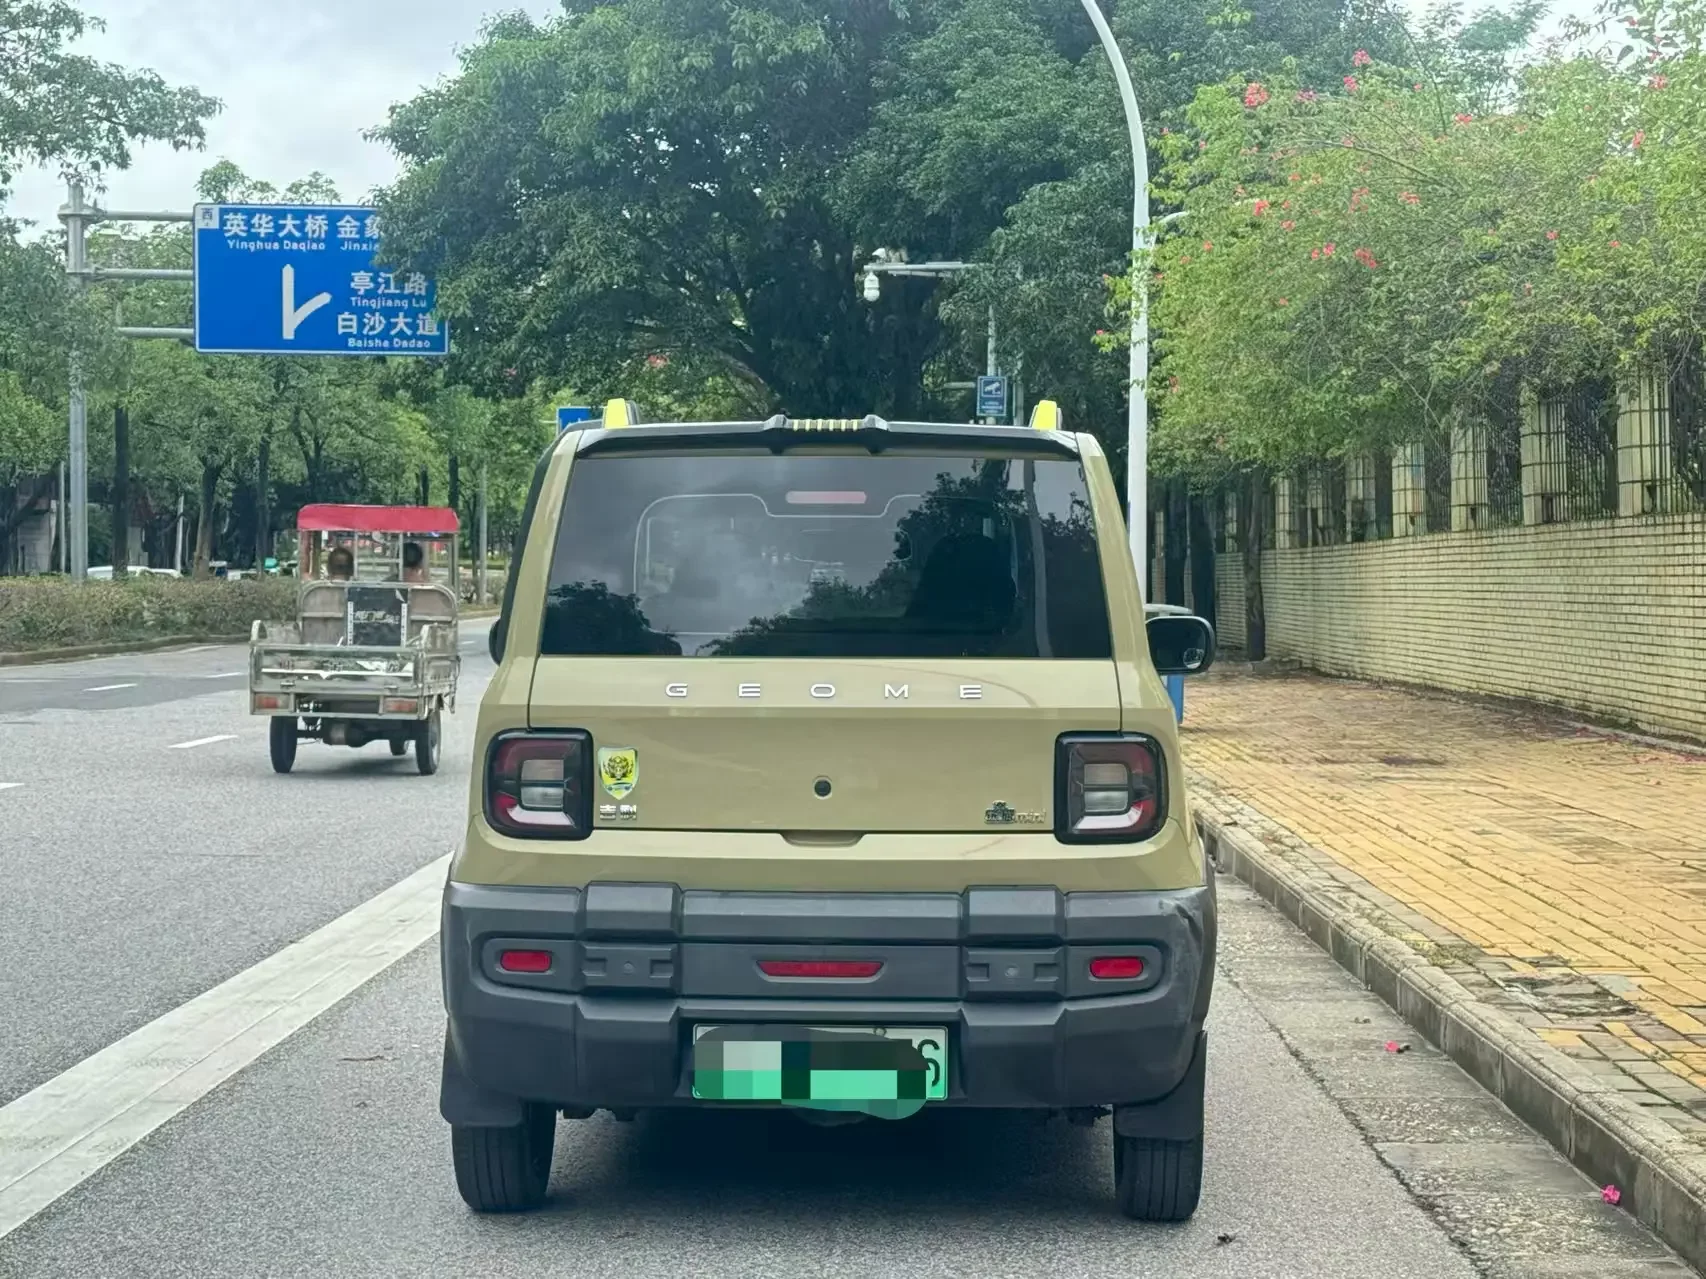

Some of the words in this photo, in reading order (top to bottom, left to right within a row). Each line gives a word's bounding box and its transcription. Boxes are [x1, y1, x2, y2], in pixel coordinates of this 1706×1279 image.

[223, 212, 329, 239] 英华大桥
[227, 239, 280, 252] Yinghua
[283, 240, 326, 252] Daqiao
[350, 270, 428, 296] 亭江路
[350, 297, 409, 310] Tingjiang
[412, 298, 427, 308] Lu
[337, 311, 441, 336] 白沙大道
[347, 337, 390, 348] Baisha
[393, 337, 431, 348] Dadao
[665, 682, 983, 699] GEOME
